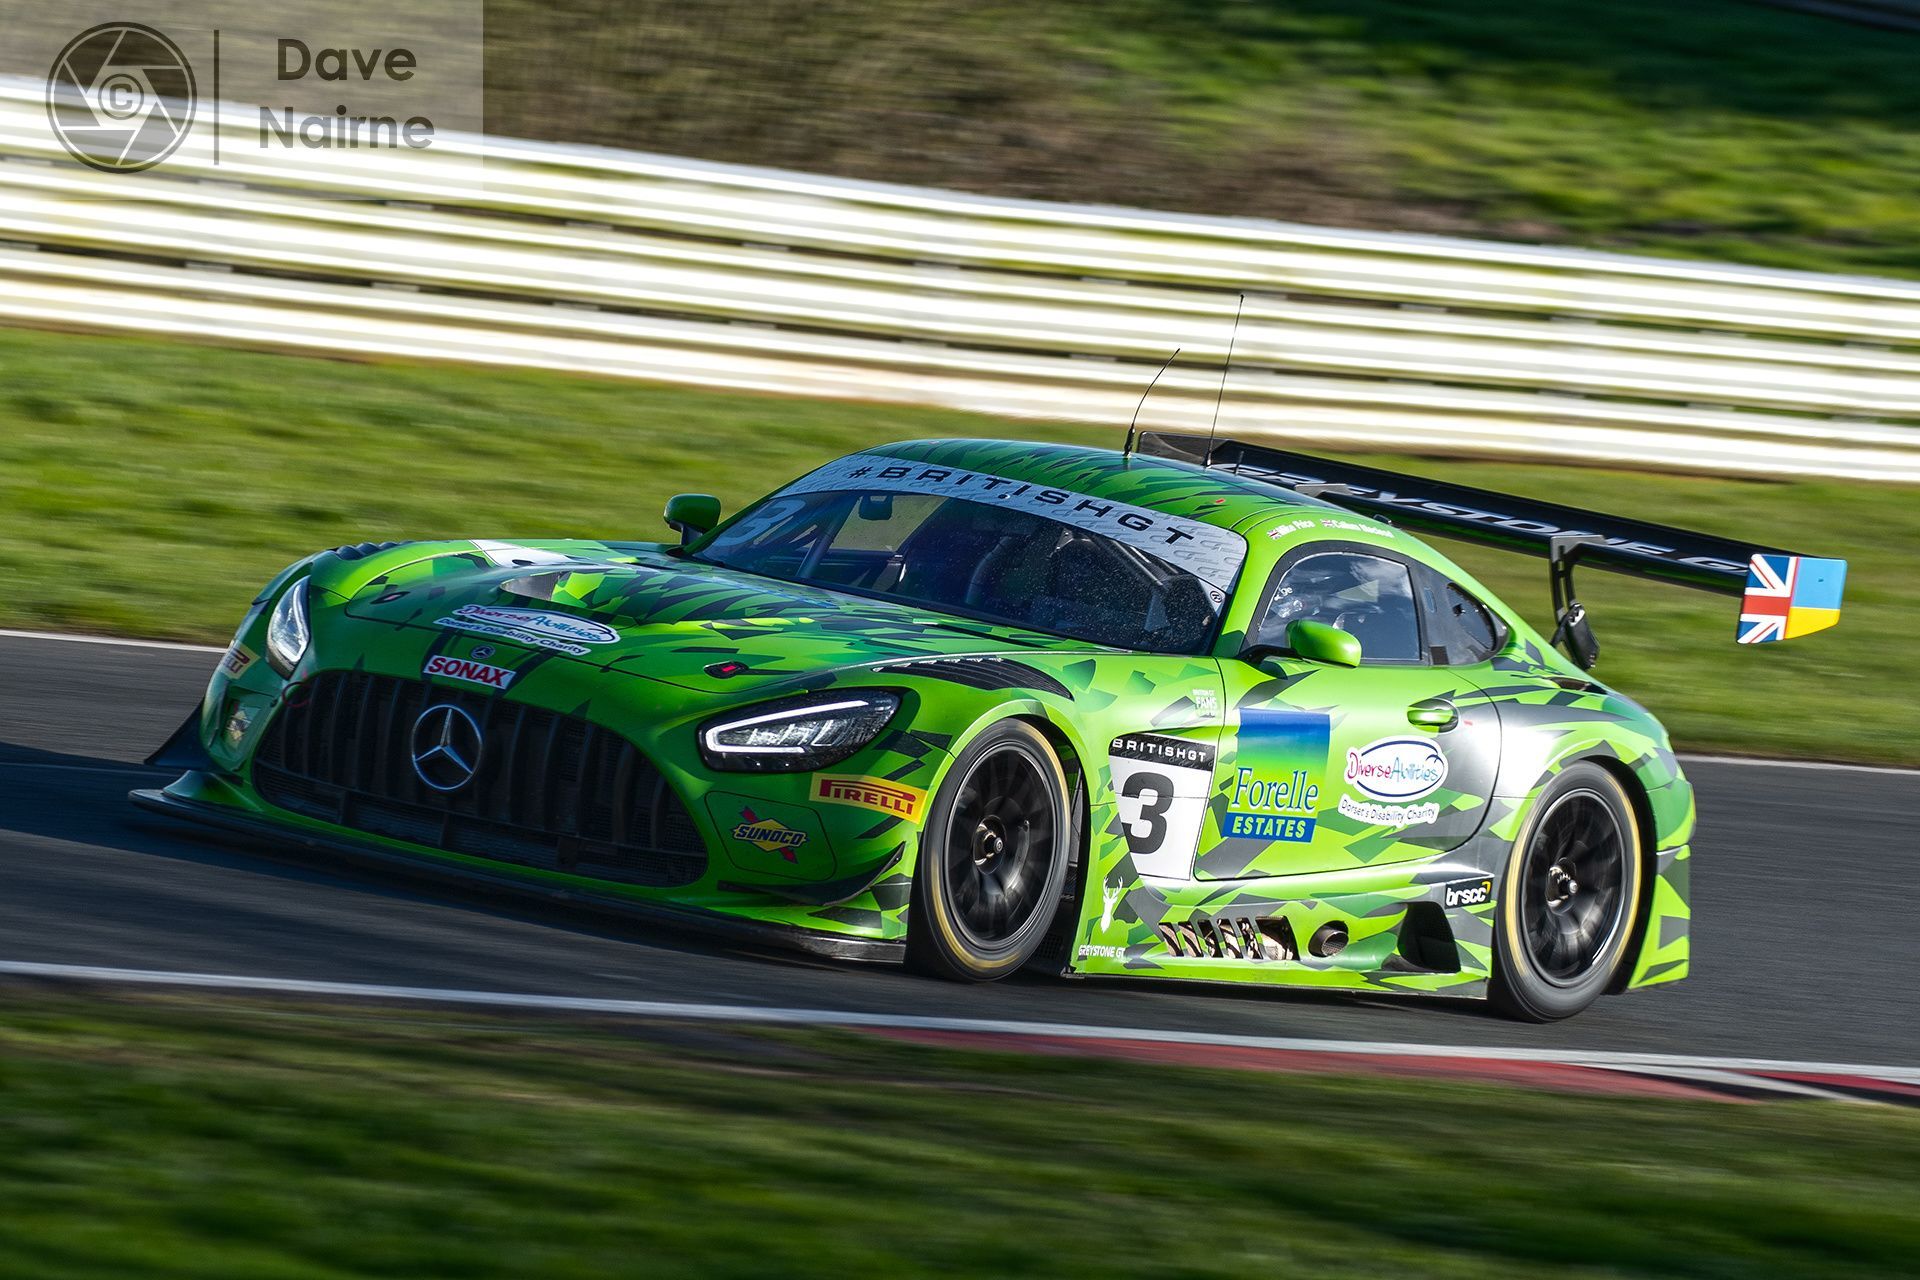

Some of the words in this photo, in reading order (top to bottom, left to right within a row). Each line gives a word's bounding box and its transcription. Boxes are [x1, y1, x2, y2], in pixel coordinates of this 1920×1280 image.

[849, 466, 1195, 545] #BRITISHGT
[539, 638, 586, 654] Charity
[428, 657, 511, 687] SONAX
[1112, 738, 1207, 762] BRITISHGT
[819, 778, 917, 815] PIRELLI
[1231, 766, 1319, 812] Forelle
[1121, 771, 1175, 855] 3
[1370, 808, 1405, 824] Disability
[1407, 807, 1436, 821] Charity
[736, 825, 805, 846] SUNOCO
[1232, 815, 1307, 839] ESTATES
[1446, 887, 1487, 907] brscc
[1078, 944, 1115, 958] GREYSTONE
[1116, 947, 1126, 960] GT
